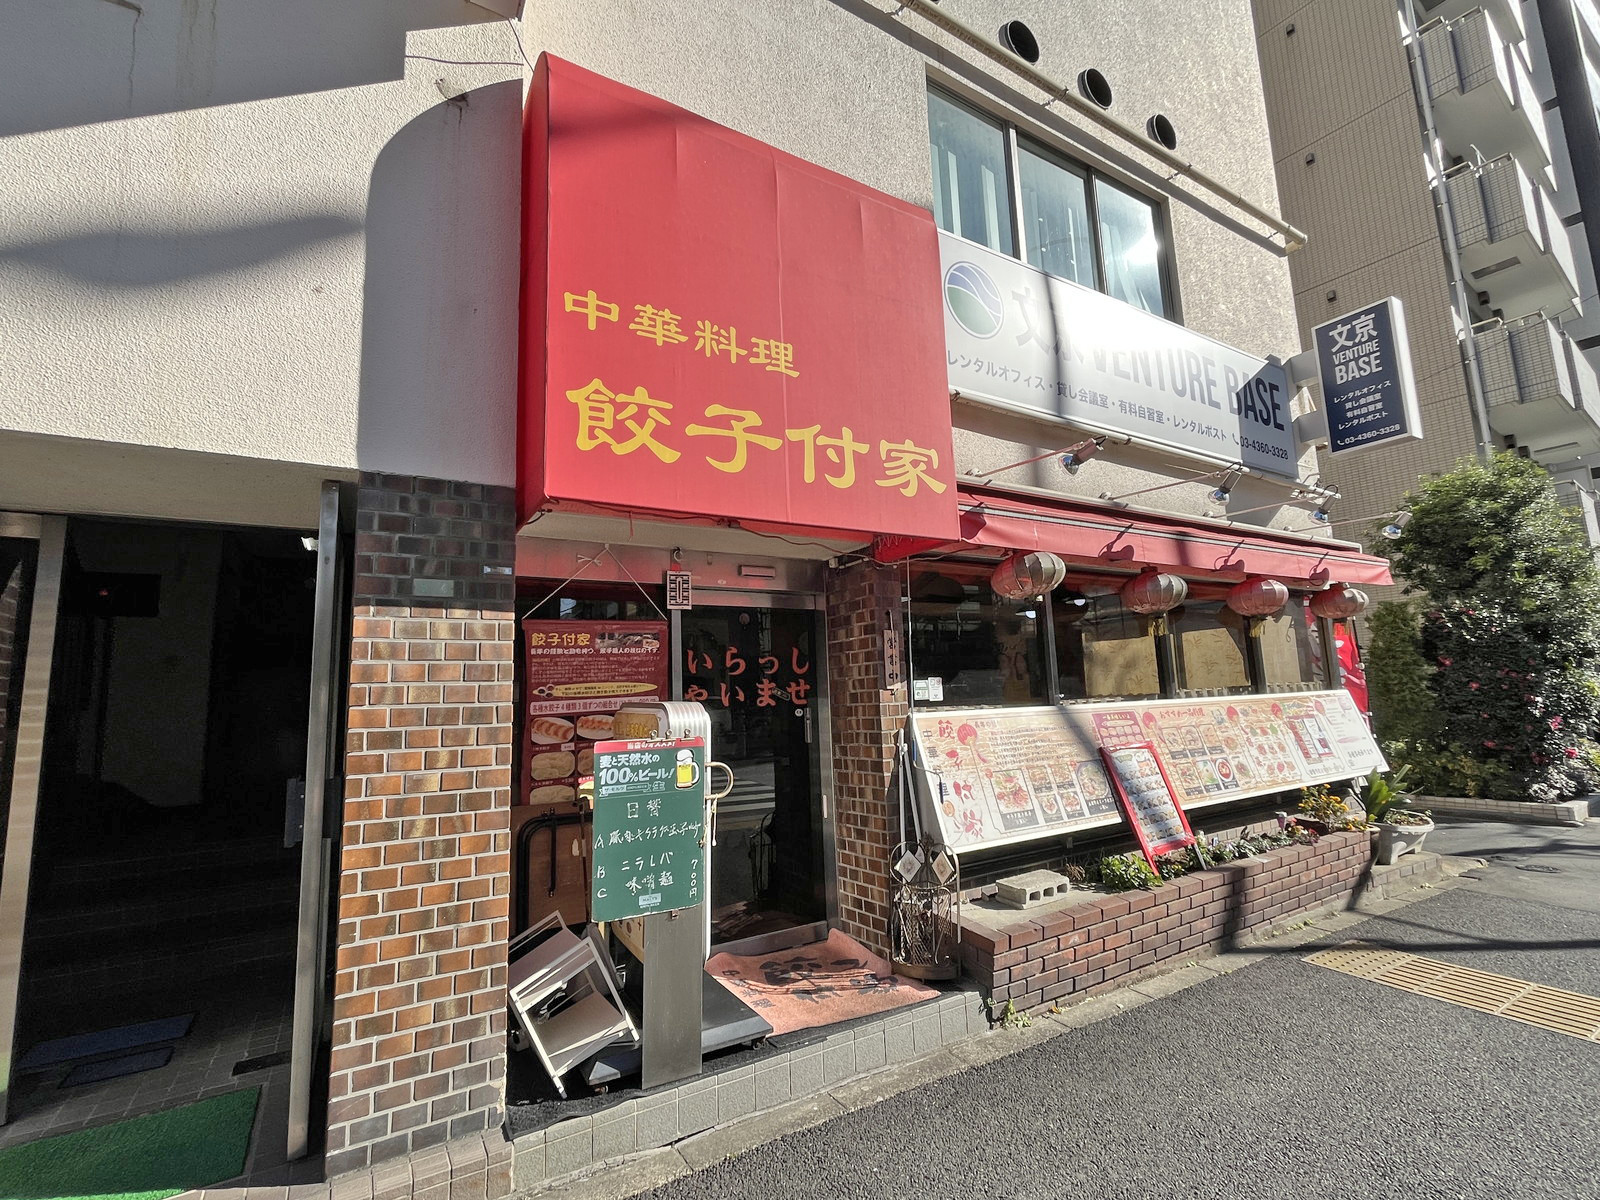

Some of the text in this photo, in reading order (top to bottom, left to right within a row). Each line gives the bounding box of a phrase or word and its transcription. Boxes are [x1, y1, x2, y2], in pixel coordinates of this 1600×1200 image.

[563, 289, 801, 379] 中華料理
[1328, 312, 1379, 353] 文京
[1332, 338, 1381, 365] VENTURE
[1334, 351, 1383, 385] BASE
[1223, 363, 1286, 432] BASE
[1333, 380, 1392, 404] レンタルオフィス
[1338, 411, 1389, 430] レンタルポスト
[564, 377, 948, 498] 餃子付家
[1344, 423, 1401, 445] 03-4360-3328
[1239, 435, 1290, 461] 03-4360-3328
[531, 632, 591, 646] 餃子付家
[686, 646, 810, 676] いらっし
[599, 752, 661, 769] 麦と天然水の
[599, 767, 676, 785] 100%ビール!
[594, 833, 605, 850] A
[596, 851, 674, 879] B ニラレバ
[597, 888, 608, 898] C
